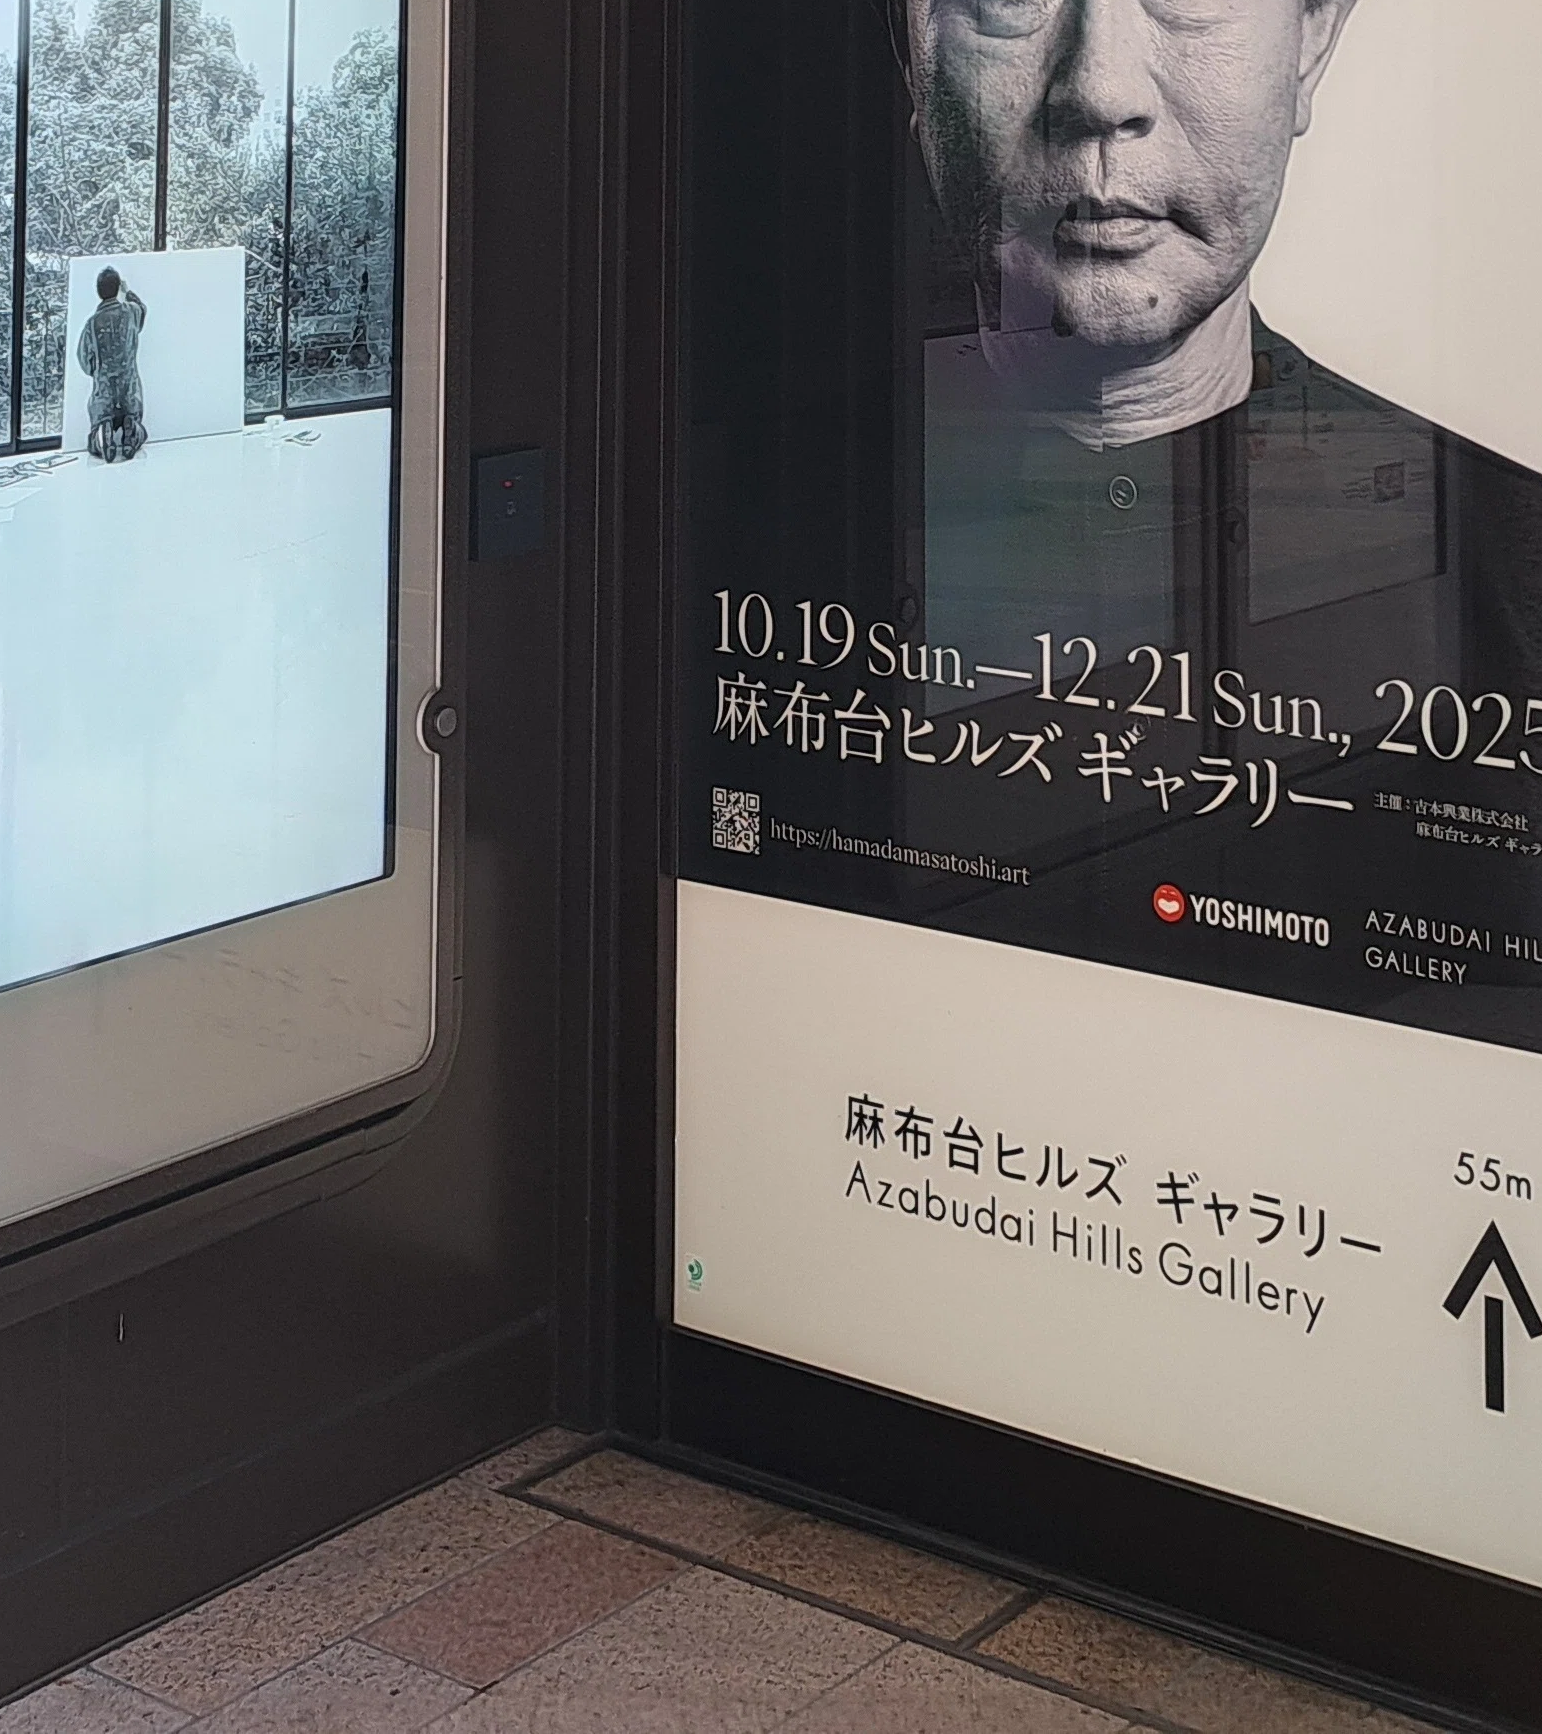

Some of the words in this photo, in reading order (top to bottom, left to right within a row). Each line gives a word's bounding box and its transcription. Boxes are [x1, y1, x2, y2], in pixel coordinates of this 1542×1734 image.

[713, 589, 856, 671] 10.19
[1213, 670, 1353, 757] Sun.,
[712, 671, 1063, 784] 麻布台ヒルズ
[1077, 732, 1355, 829] ギャラリー
[769, 817, 1032, 886] https://hamadamasatoshi.art
[1416, 821, 1500, 850] 麻布台ヒルズ
[1189, 893, 1331, 949] YOSHIMOTO
[1365, 910, 1492, 954] AZABUDAI
[1365, 947, 1467, 985] GALLERY
[844, 1092, 1128, 1207] 麻布台ヒルズ
[1155, 1169, 1383, 1258] ギャラリー
[1454, 1150, 1533, 1201] 55m
[844, 1159, 1036, 1247] Azabudai
[1052, 1209, 1144, 1276] Hills
[1159, 1241, 1325, 1334] Gallery
